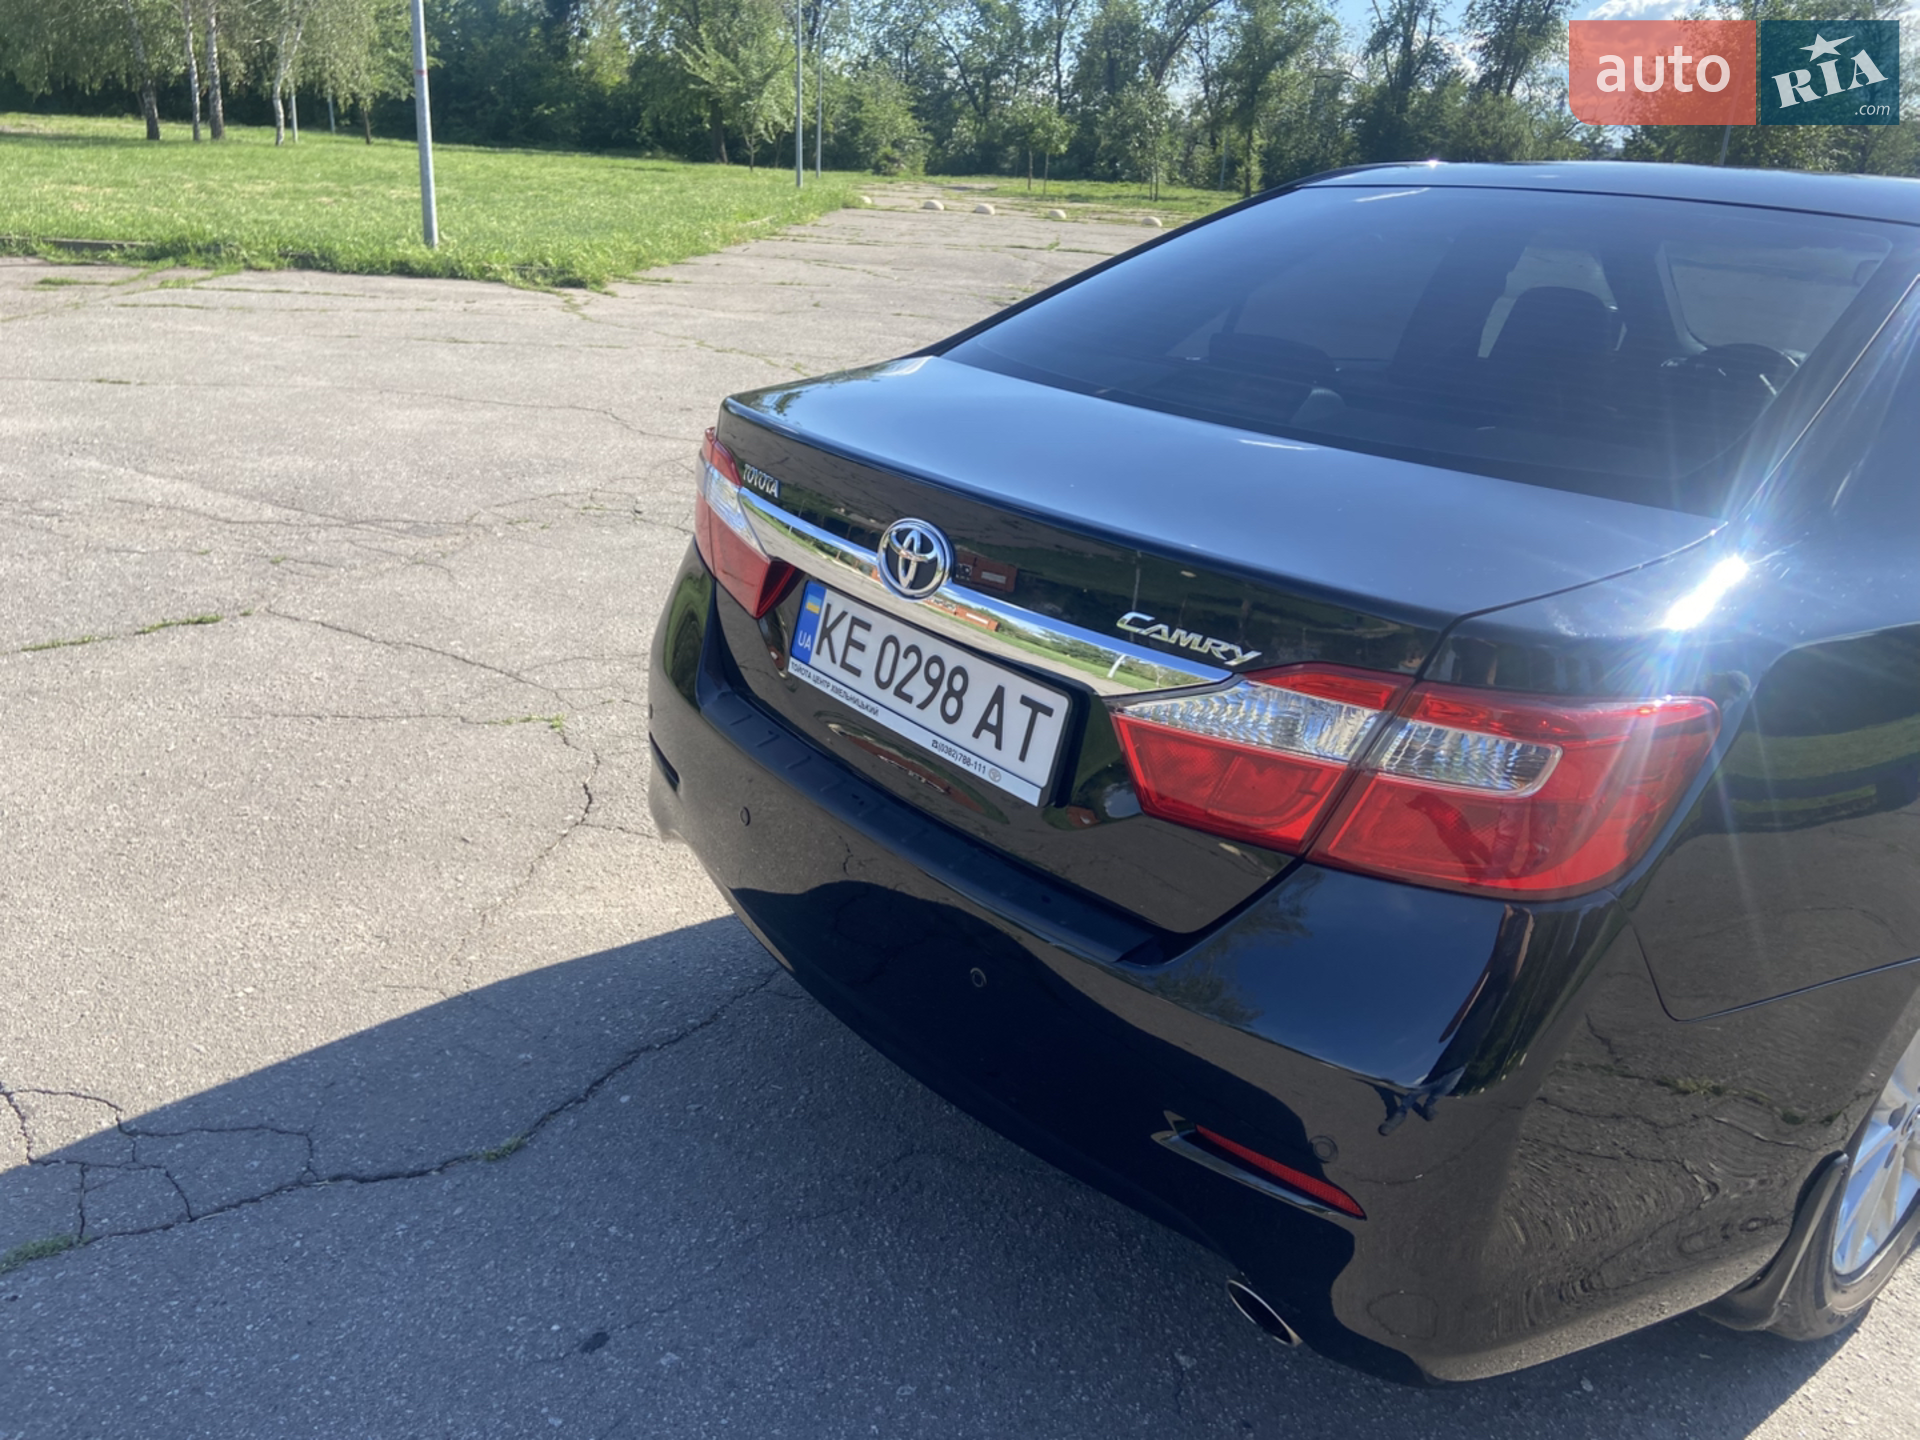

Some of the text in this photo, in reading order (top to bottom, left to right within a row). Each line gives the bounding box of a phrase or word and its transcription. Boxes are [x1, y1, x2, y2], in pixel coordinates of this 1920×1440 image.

[743, 463, 780, 498] TOYOTA
[798, 631, 812, 651] UA
[1116, 611, 1262, 666] CAMRY
[874, 634, 969, 725] 0298
[971, 684, 1055, 762] AT
